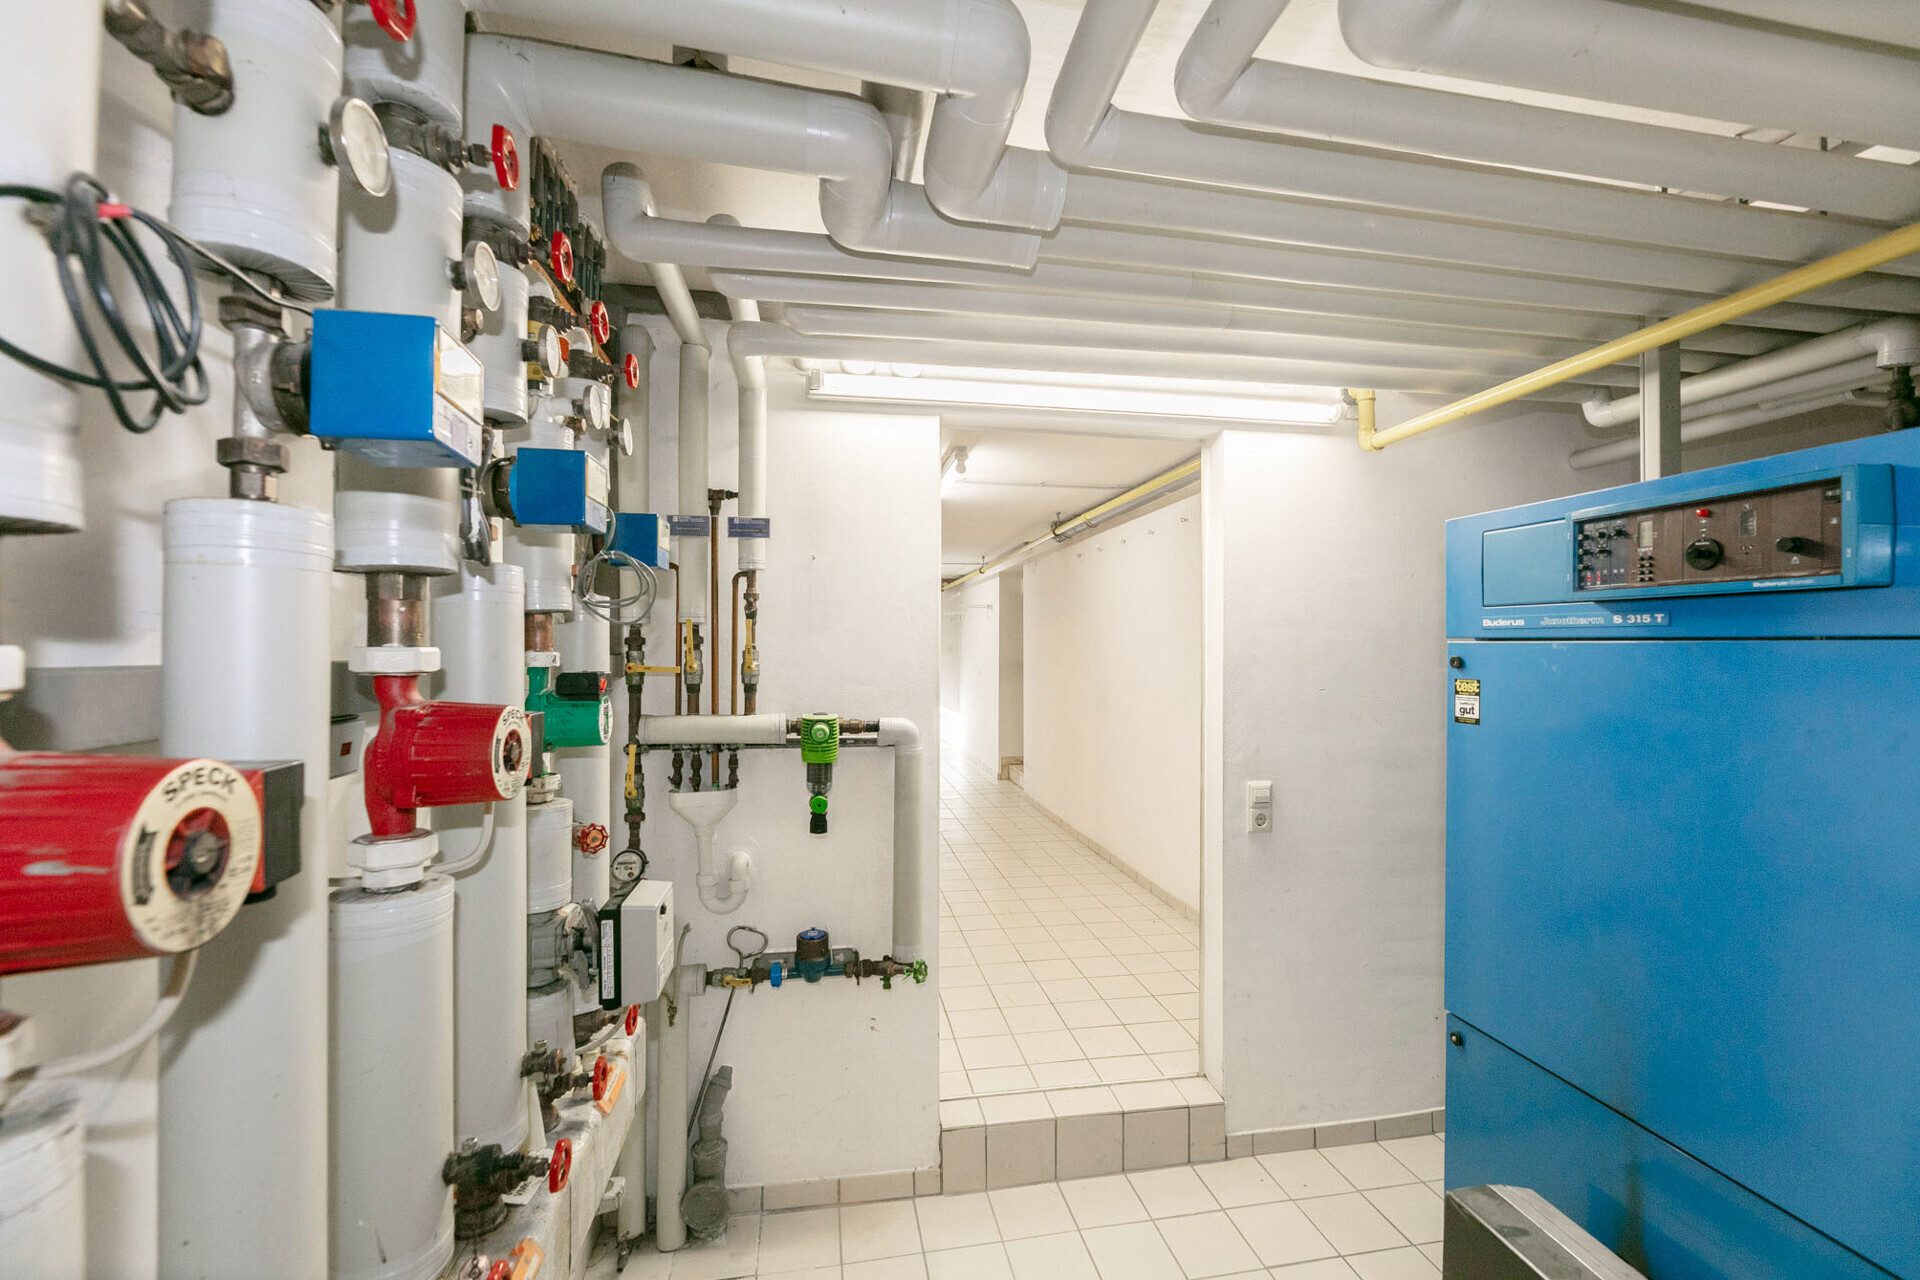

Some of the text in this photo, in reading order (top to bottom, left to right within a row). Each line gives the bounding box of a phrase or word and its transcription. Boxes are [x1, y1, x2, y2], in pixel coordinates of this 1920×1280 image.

[1482, 617, 1525, 628] Buderus
[1612, 614, 1623, 624] S
[1626, 614, 1651, 624] 315
[1654, 613, 1665, 623] T
[1455, 679, 1480, 692] test
[1459, 706, 1475, 716] gut
[163, 766, 237, 803] SPECK
